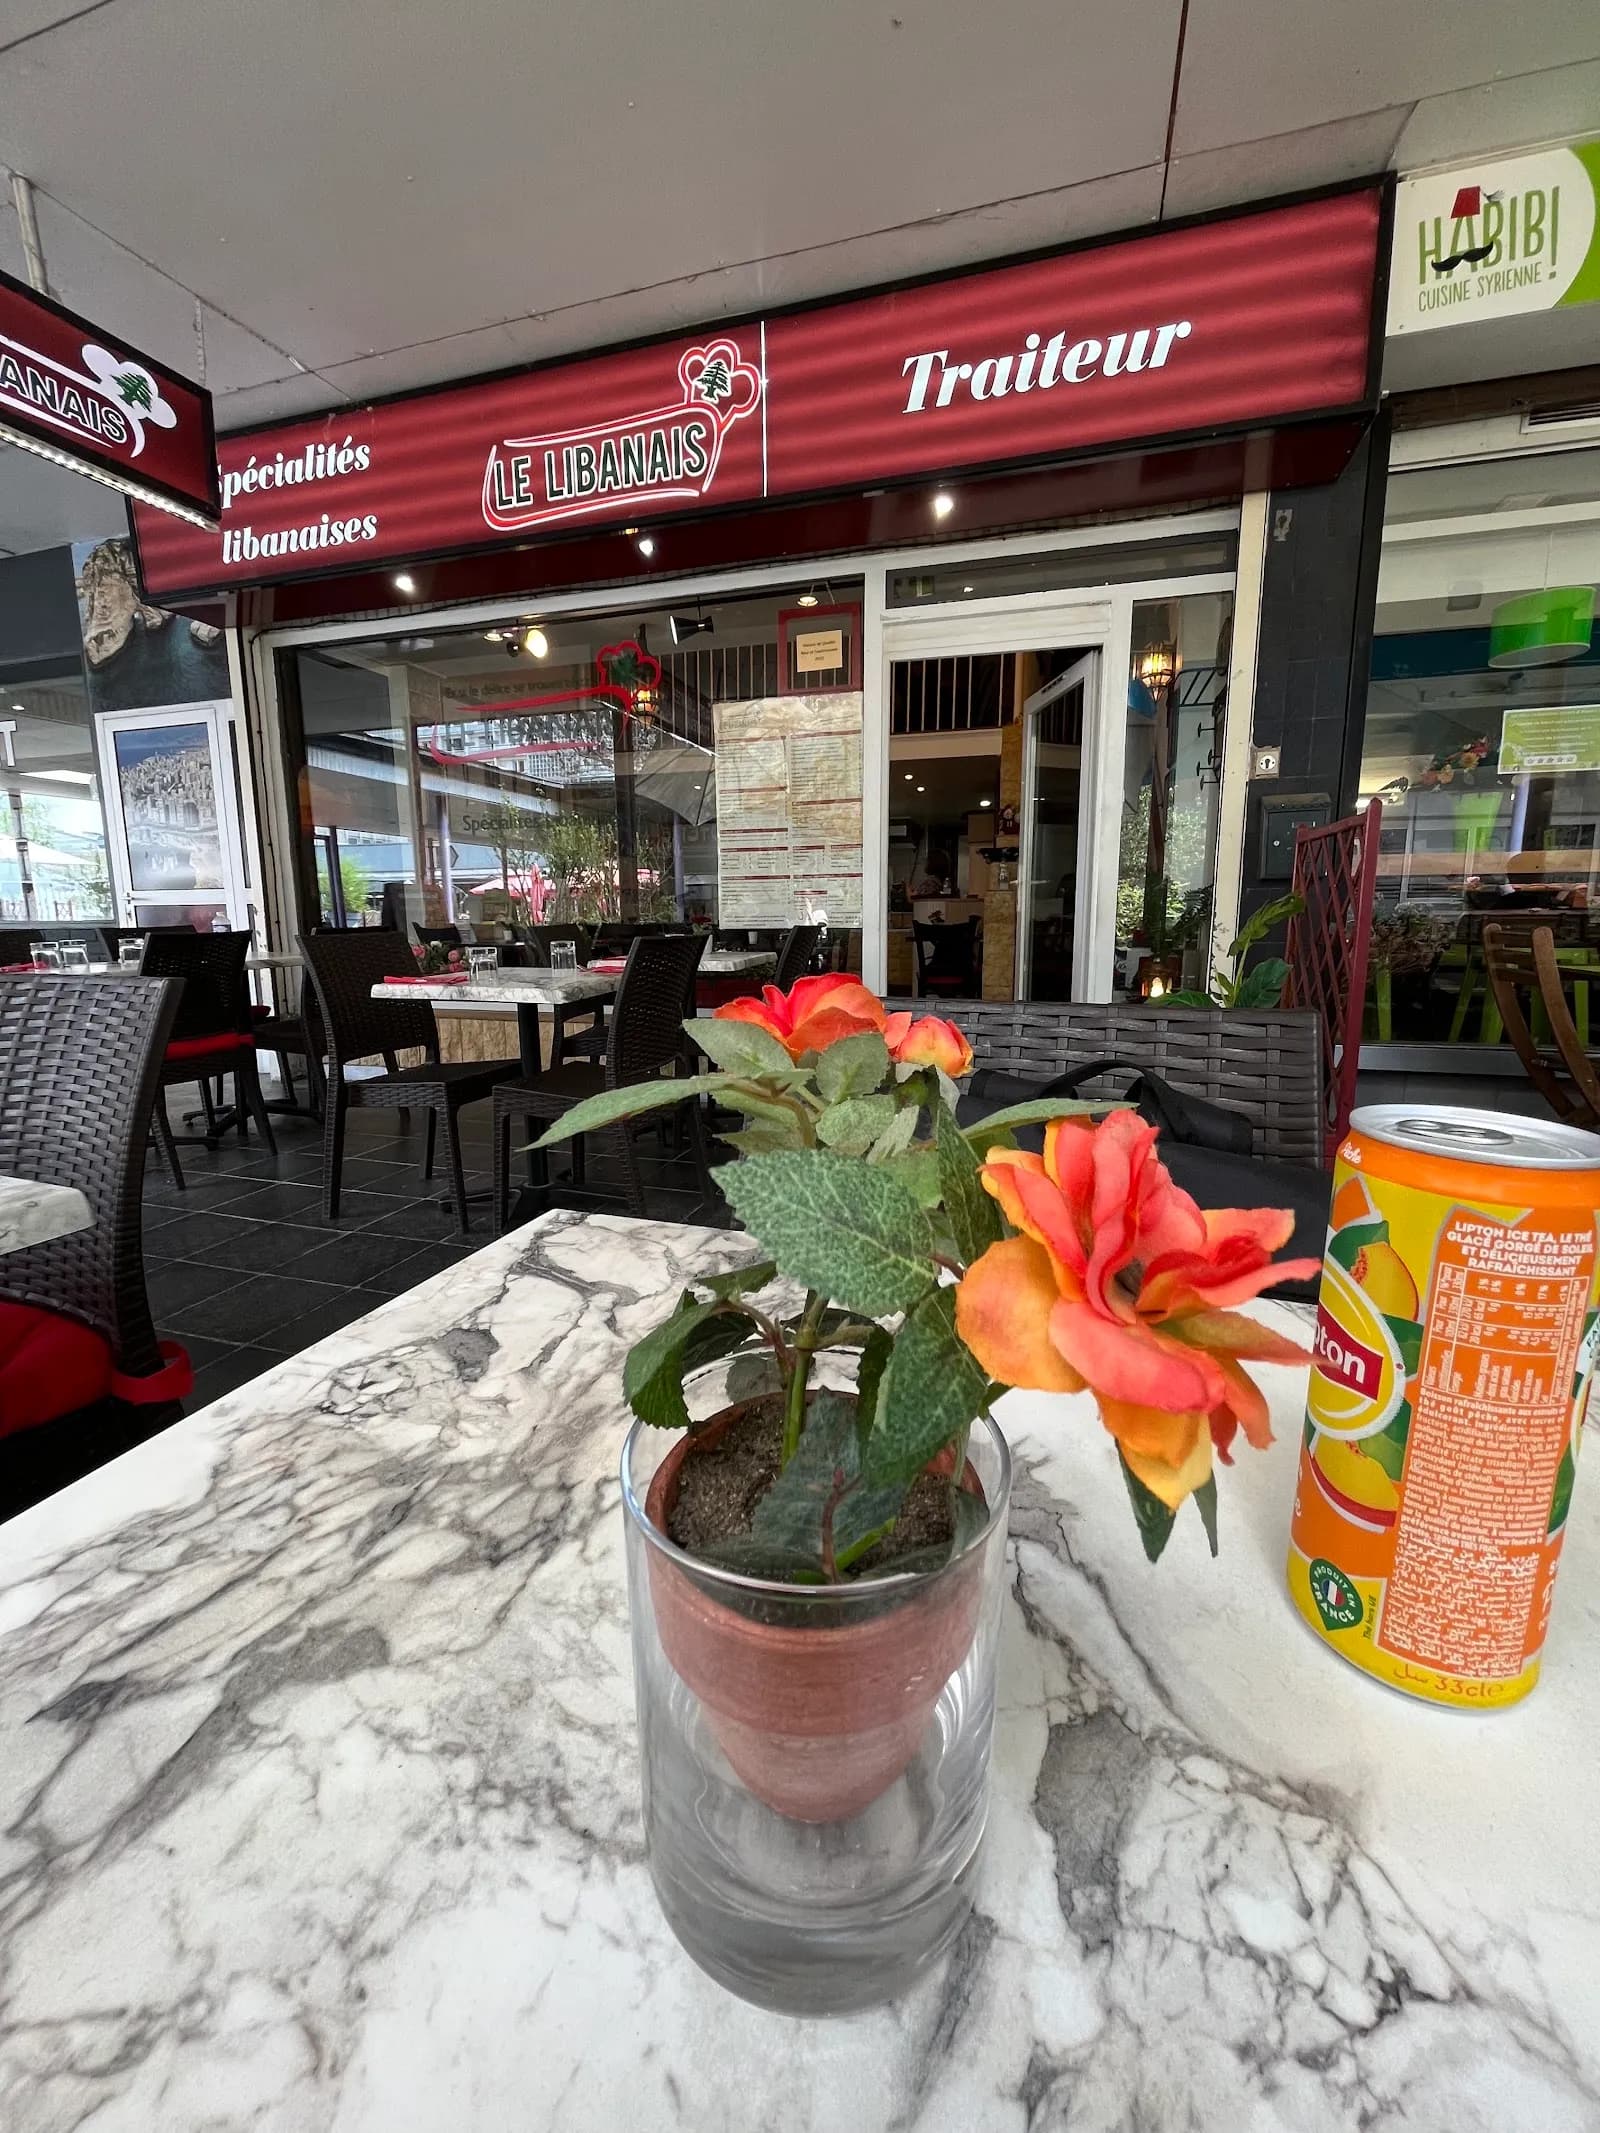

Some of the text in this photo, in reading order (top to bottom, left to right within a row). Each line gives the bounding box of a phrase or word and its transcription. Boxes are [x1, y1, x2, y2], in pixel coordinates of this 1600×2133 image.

[1418, 262, 1542, 312] CUISINE SYRIENNE
[902, 321, 1192, 413] Traiteur
[494, 422, 707, 510] LE LIBANAIS
[222, 514, 377, 564] libanaises
[1447, 1231, 1491, 1248] GLACÉ
[1494, 1239, 1541, 1254] GORGÉ
[1544, 1244, 1559, 1254] DE
[1455, 1221, 1503, 1239] LIPTON
[1507, 1229, 1528, 1241] ICE
[1560, 1233, 1573, 1243] LE
[1461, 1245, 1582, 1266] ET DÉLICIEUSEMENT
[1468, 1257, 1577, 1277] RAFRAÎCHISSANT
[1314, 1566, 1349, 1589] PRODUIT
[1312, 1582, 1354, 1623] FRANCE
[1346, 1593, 1356, 1608] EN
